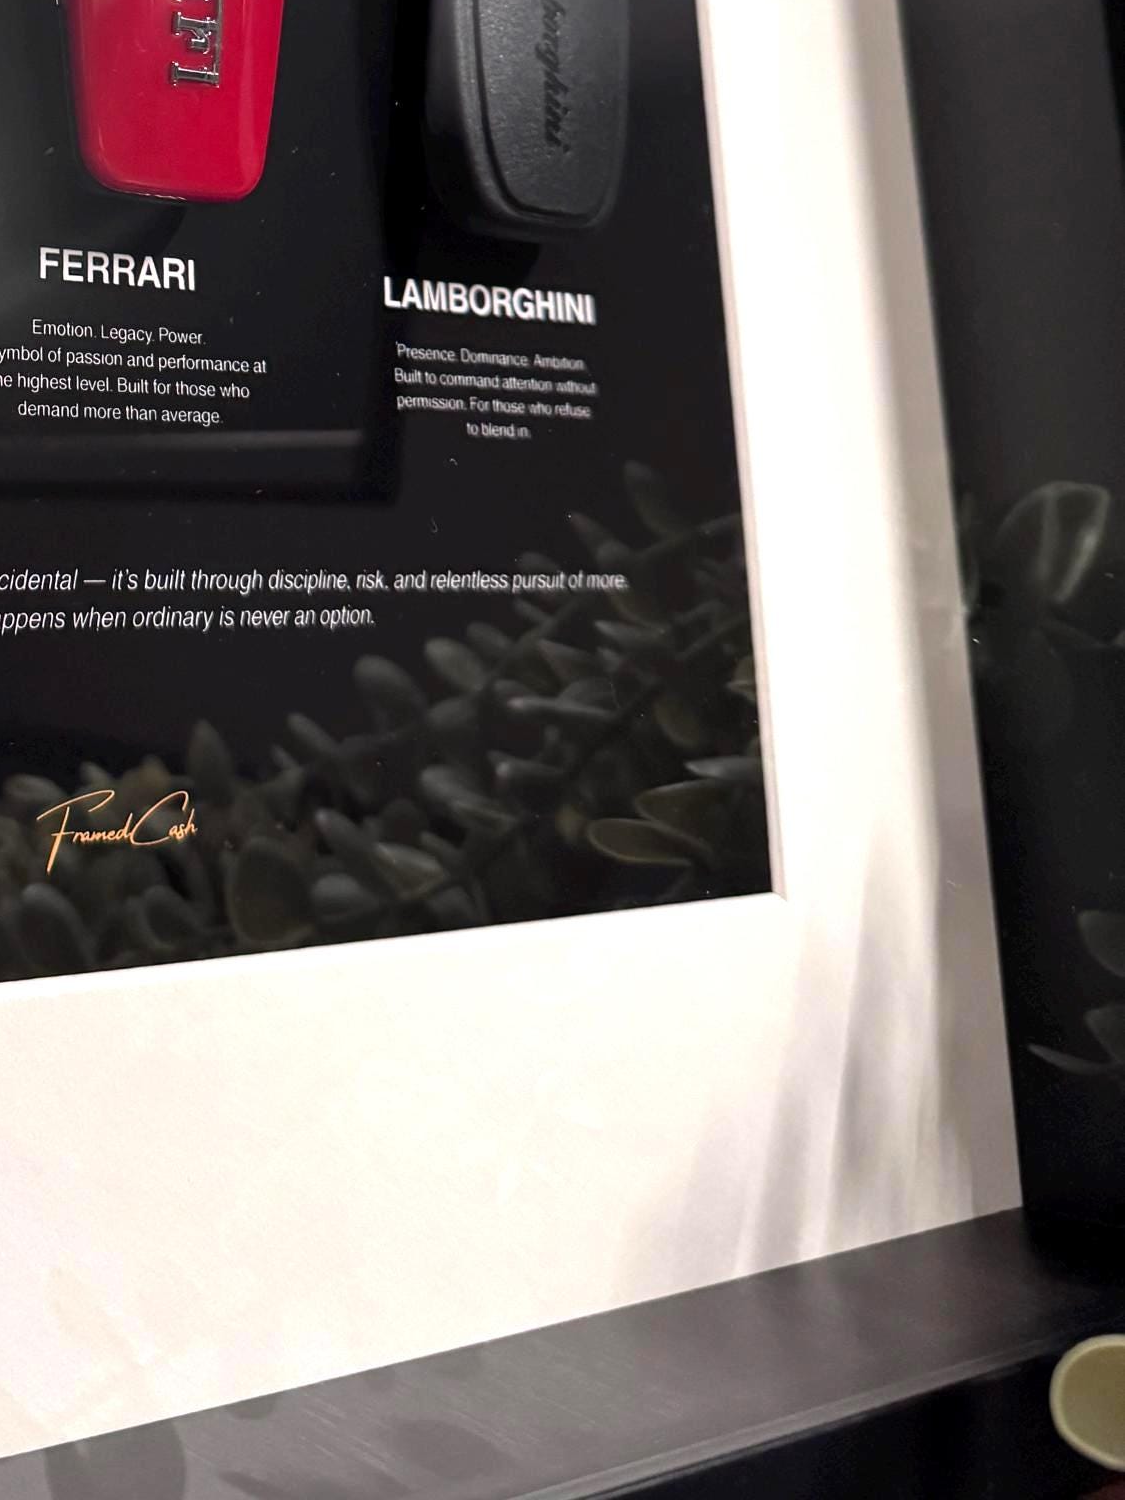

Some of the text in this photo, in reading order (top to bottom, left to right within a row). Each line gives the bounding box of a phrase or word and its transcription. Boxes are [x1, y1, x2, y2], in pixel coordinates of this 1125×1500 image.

[39, 246, 196, 291] FERRARI
[383, 276, 597, 325] LAMBORGHINI
[32, 318, 206, 345] Emotion. Legacy. Power.
[47, 347, 63, 362] of
[66, 350, 123, 368] passion
[126, 352, 154, 368] and
[158, 354, 250, 374] performance
[253, 359, 267, 373] at
[17, 373, 72, 393] highest
[76, 375, 113, 392] level.
[117, 377, 149, 394] Built
[152, 378, 171, 395] for
[175, 380, 216, 397] those
[220, 383, 250, 399] who
[394, 368, 596, 395] Built to command attention without
[18, 401, 224, 426] demand more than average.
[397, 394, 591, 418] permission. For those who refuse
[467, 422, 479, 435] to
[481, 423, 515, 438] blend
[144, 567, 185, 591] built
[190, 567, 263, 596] through
[268, 568, 351, 596] discipline,
[393, 569, 426, 590] and
[430, 569, 508, 590] relentless
[511, 570, 565, 595] pursuit
[567, 570, 584, 589] of
[585, 573, 628, 590] more.
[72, 606, 126, 631] when
[132, 605, 214, 633] ordinary
[219, 605, 235, 628] is
[239, 607, 290, 628] never
[294, 608, 316, 627] an
[318, 605, 375, 630] option.
